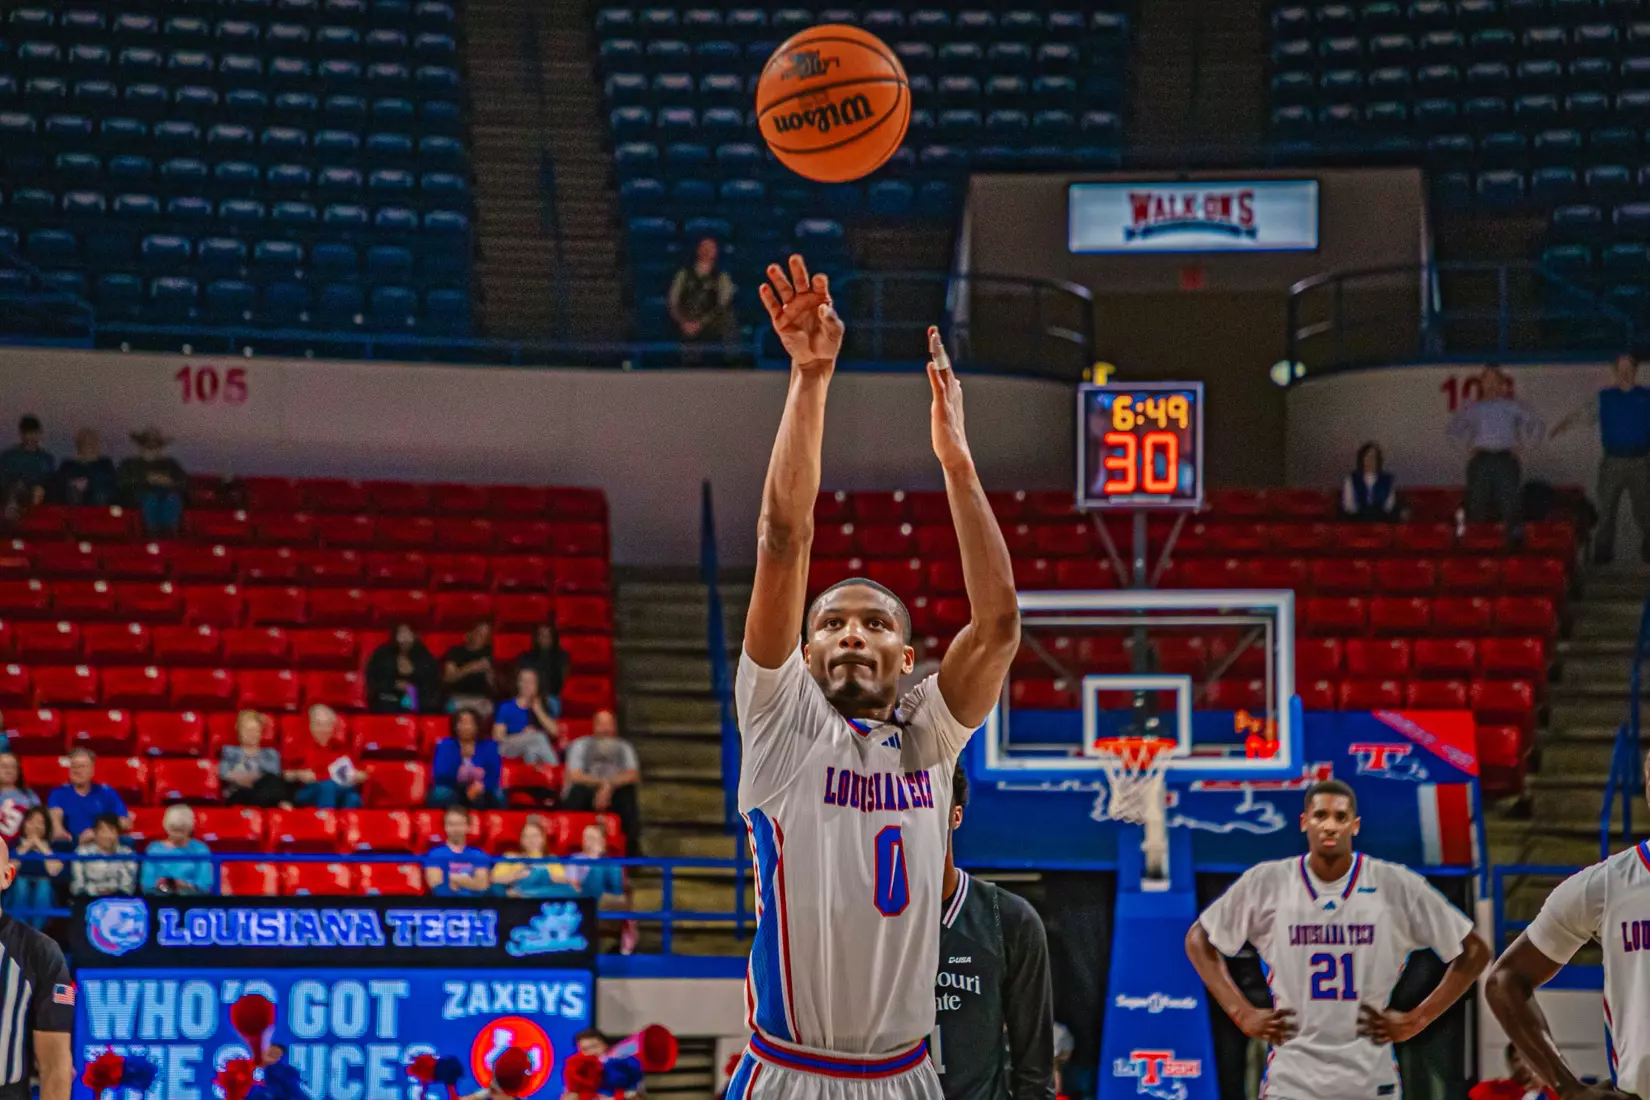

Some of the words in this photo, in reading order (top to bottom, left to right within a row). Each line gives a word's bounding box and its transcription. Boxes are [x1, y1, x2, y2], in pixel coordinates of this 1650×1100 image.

[773, 93, 876, 134] Wilson
[174, 363, 249, 404] 105
[1111, 394, 1190, 431] 6:49
[1103, 431, 1180, 496] 30
[873, 824, 911, 918] 0
[157, 908, 386, 947] LOUISIANA
[385, 908, 498, 947] TECH
[934, 970, 982, 996] ouri
[1309, 952, 1358, 1001] 21
[82, 979, 278, 1041] WHO'
[288, 979, 411, 1040] GOT
[442, 980, 587, 1021] ZAXBYS
